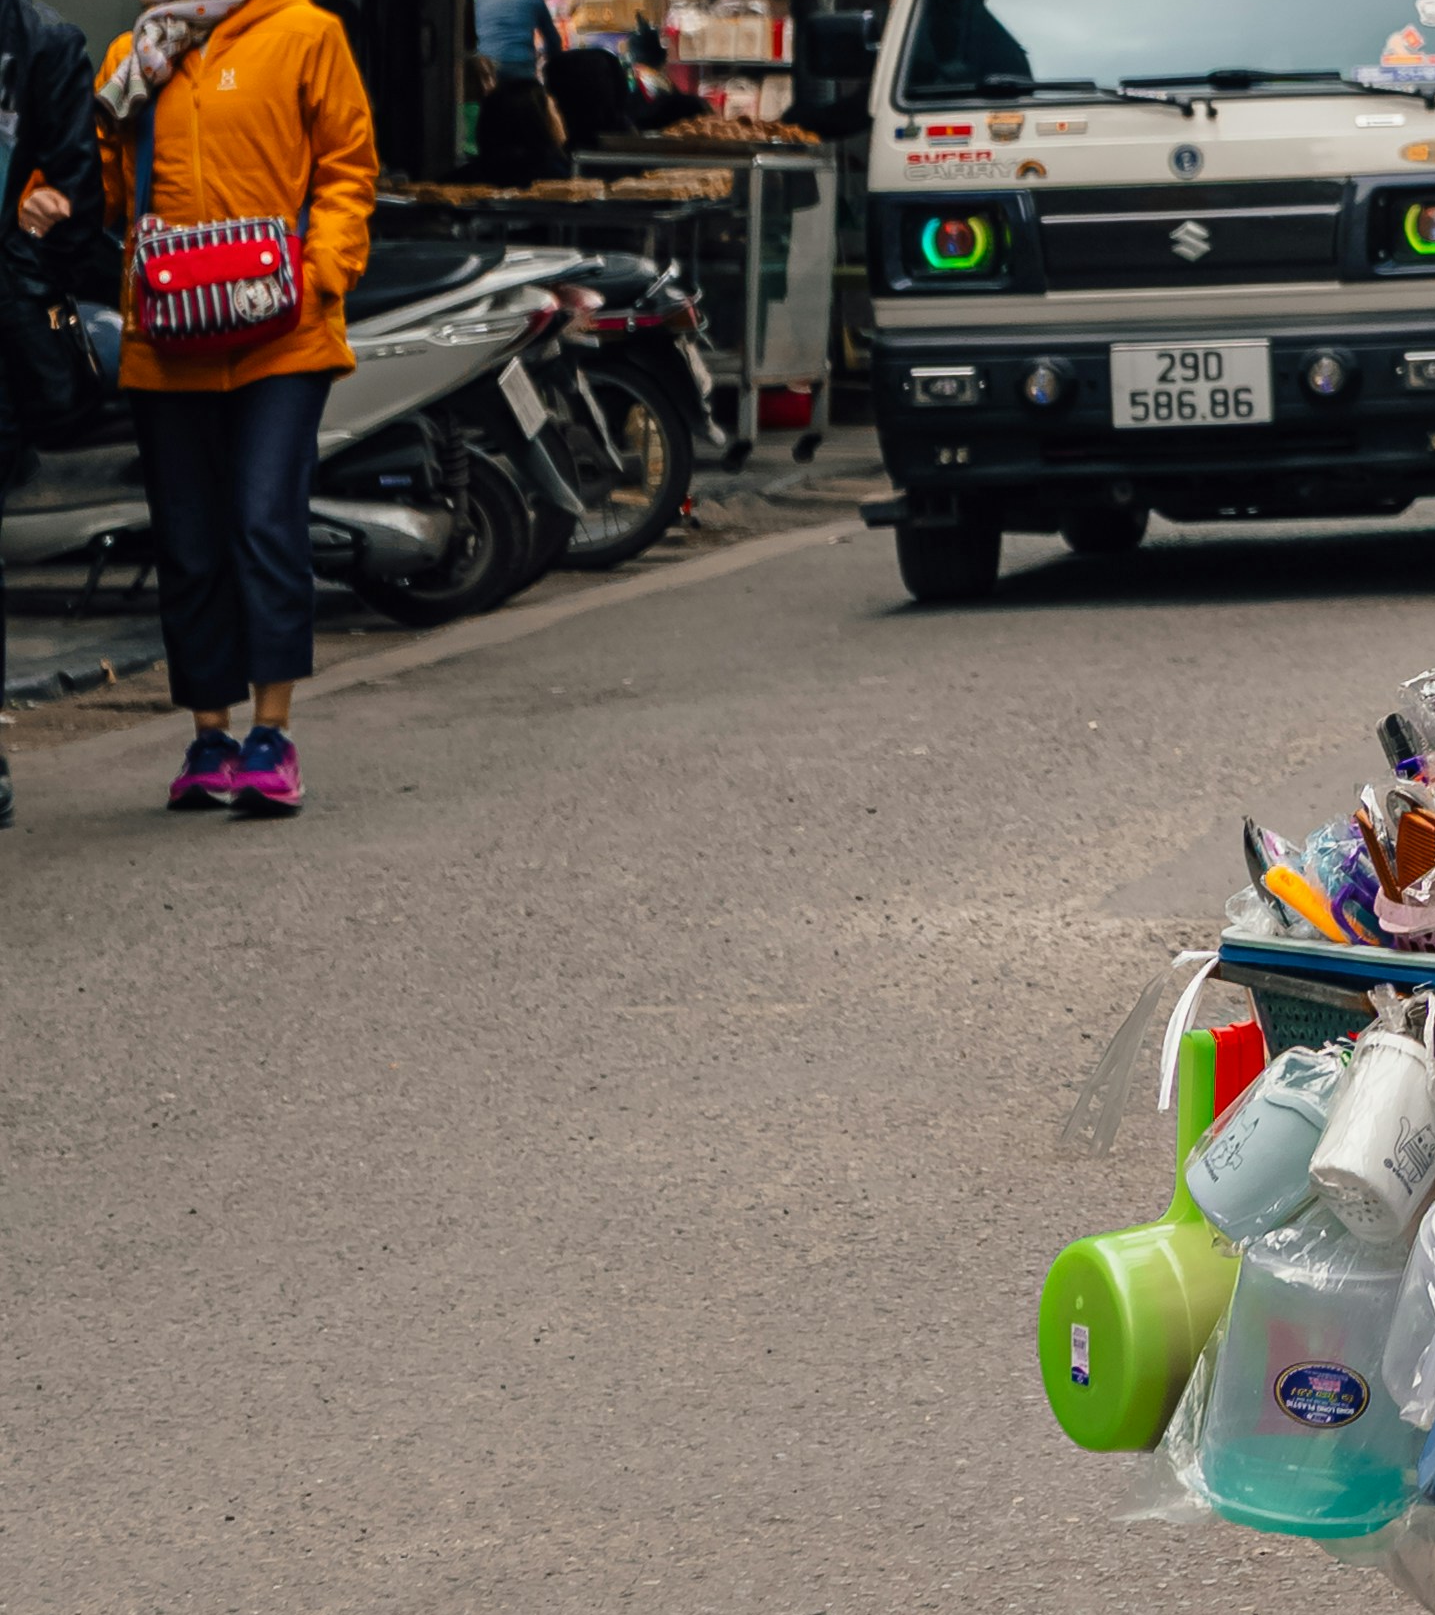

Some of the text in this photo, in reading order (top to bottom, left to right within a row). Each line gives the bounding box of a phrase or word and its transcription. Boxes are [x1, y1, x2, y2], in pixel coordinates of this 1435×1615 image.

[904, 160, 1015, 182] CARRY
[907, 149, 993, 166] SUPER
[1156, 350, 1224, 386] 29D
[1129, 384, 1254, 424] 586.86
